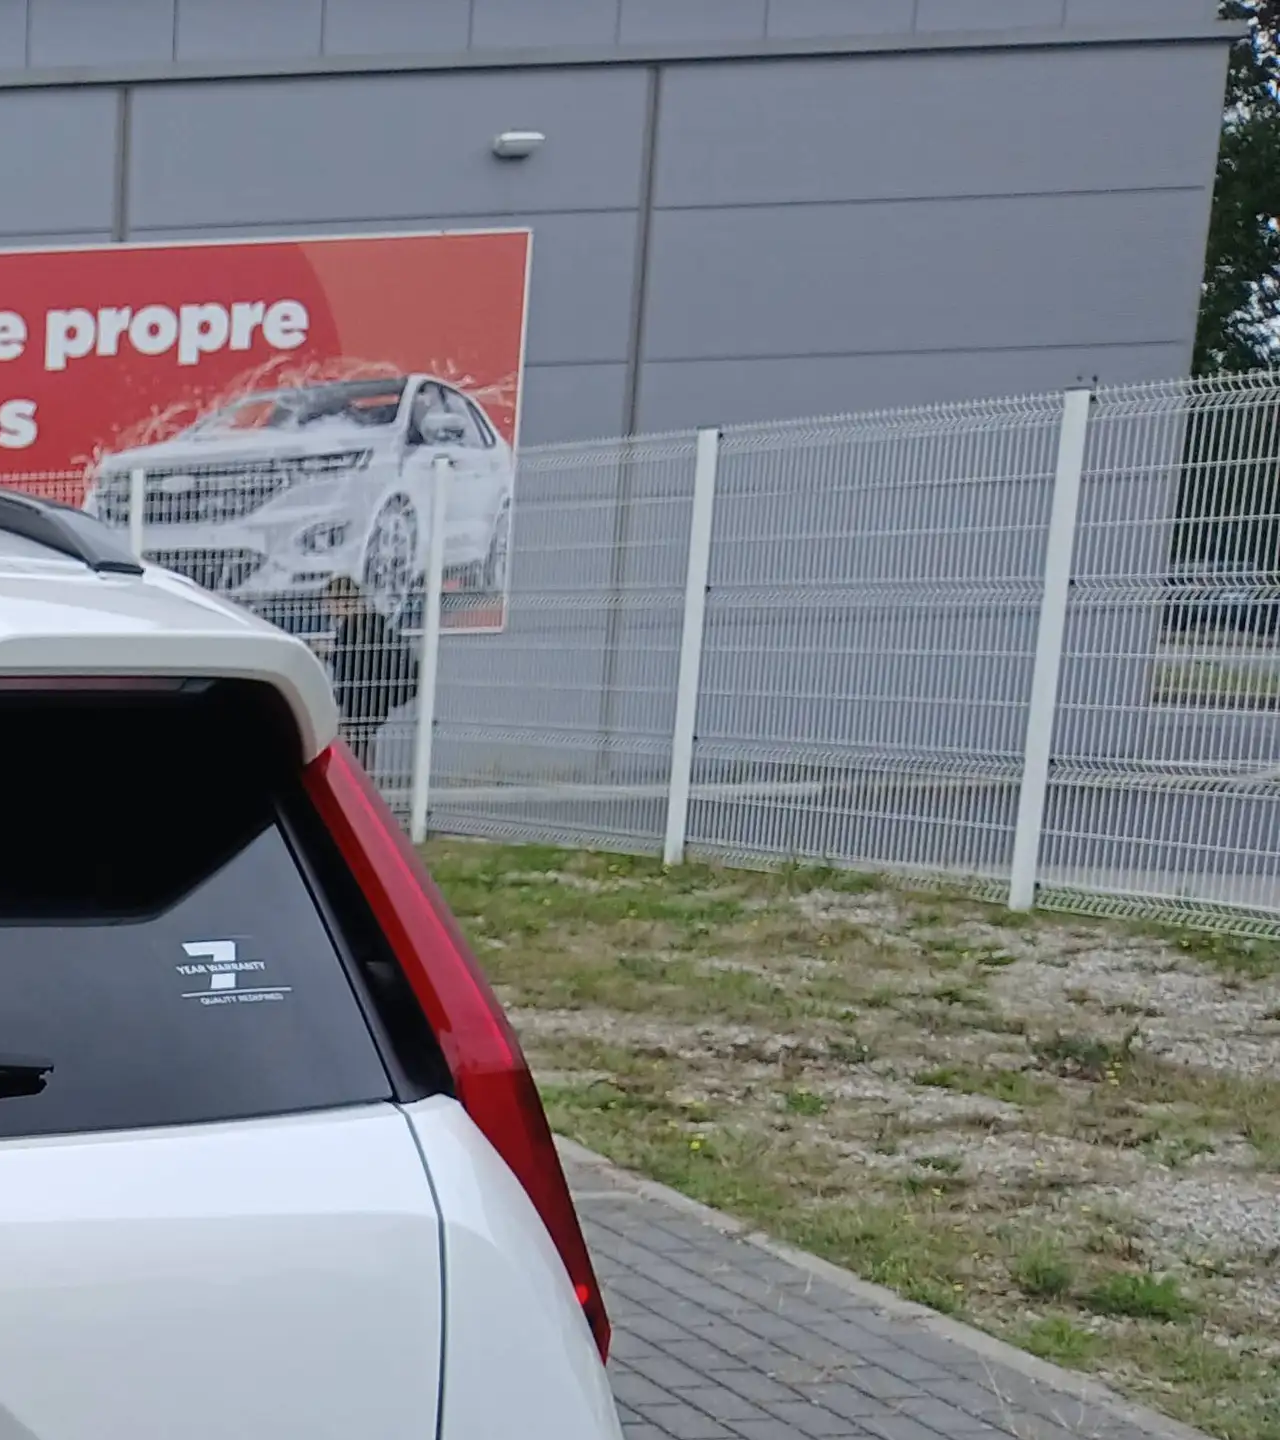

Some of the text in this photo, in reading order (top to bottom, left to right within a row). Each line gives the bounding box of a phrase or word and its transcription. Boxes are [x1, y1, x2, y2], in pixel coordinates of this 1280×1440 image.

[44, 298, 308, 371] propre
[175, 961, 266, 976] YEAR WARRANTY
[200, 995, 237, 1006] QUALITY
